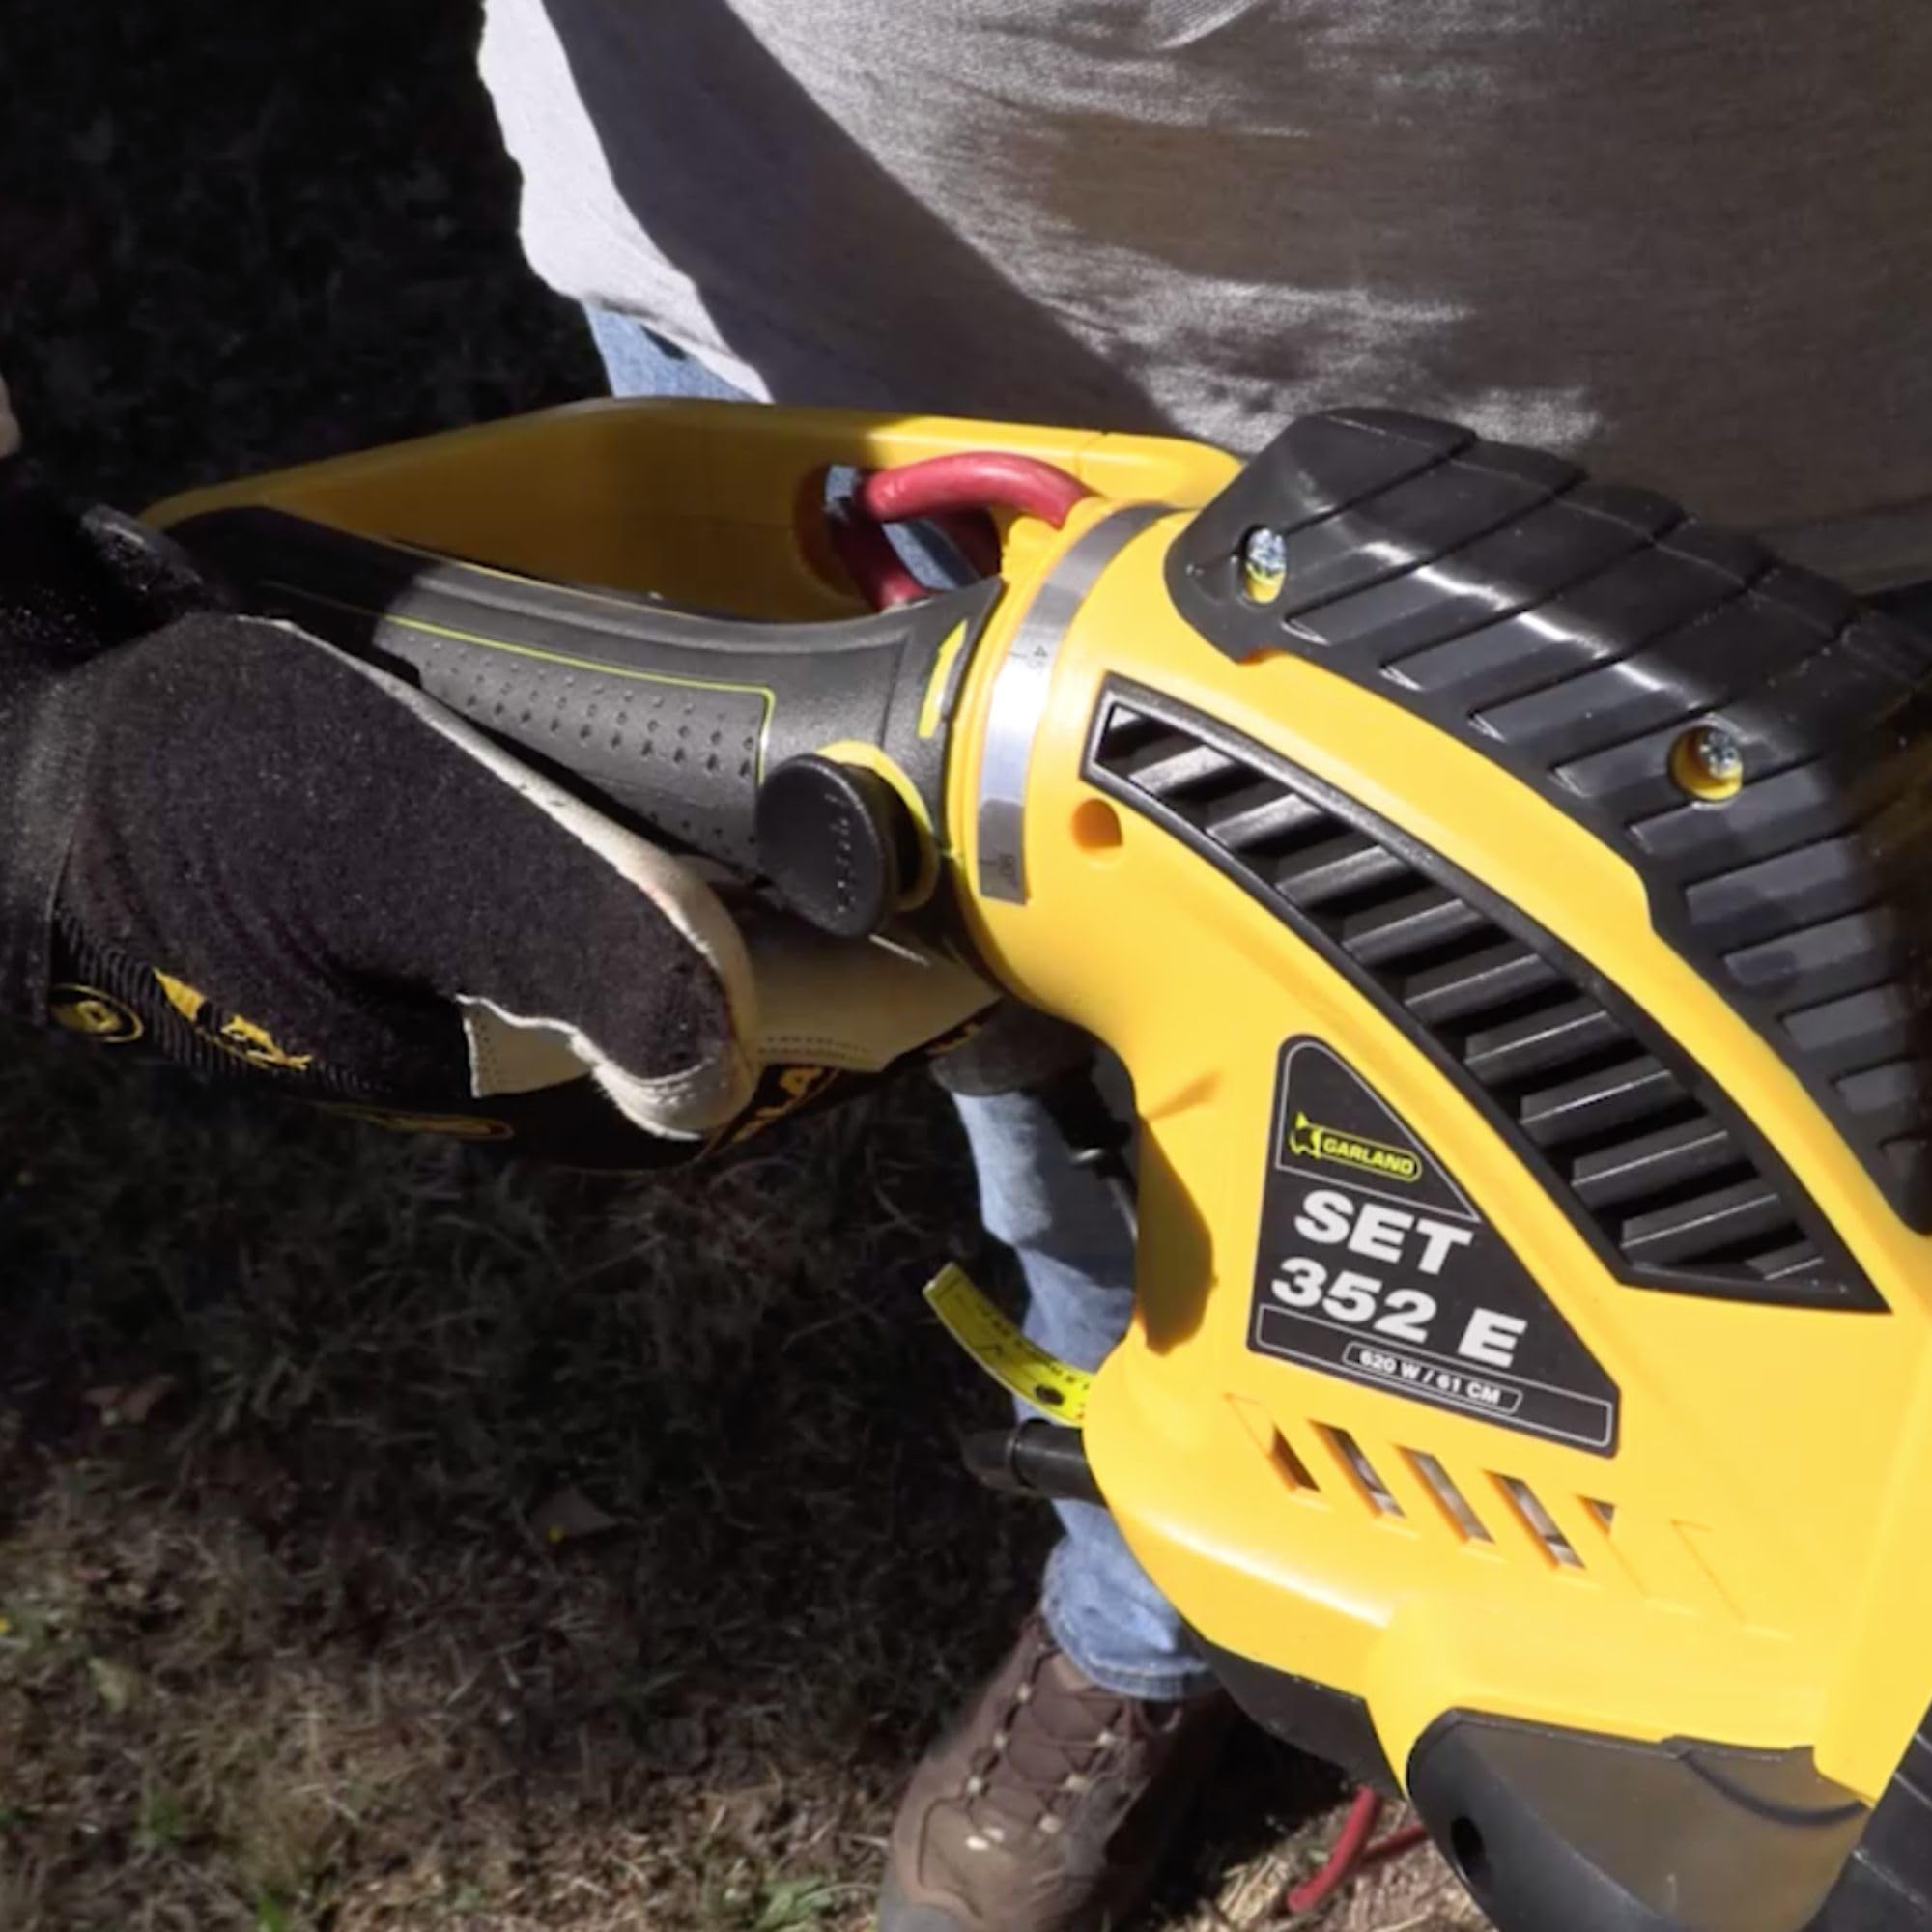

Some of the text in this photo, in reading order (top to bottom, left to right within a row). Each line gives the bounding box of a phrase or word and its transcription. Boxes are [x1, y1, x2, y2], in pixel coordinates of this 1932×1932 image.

[1322, 1137, 1414, 1175] GARLAND
[1294, 1189, 1474, 1275] SET
[1271, 1257, 1528, 1368] 352 E
[1359, 1349, 1501, 1404] 620 W / 61 CM
